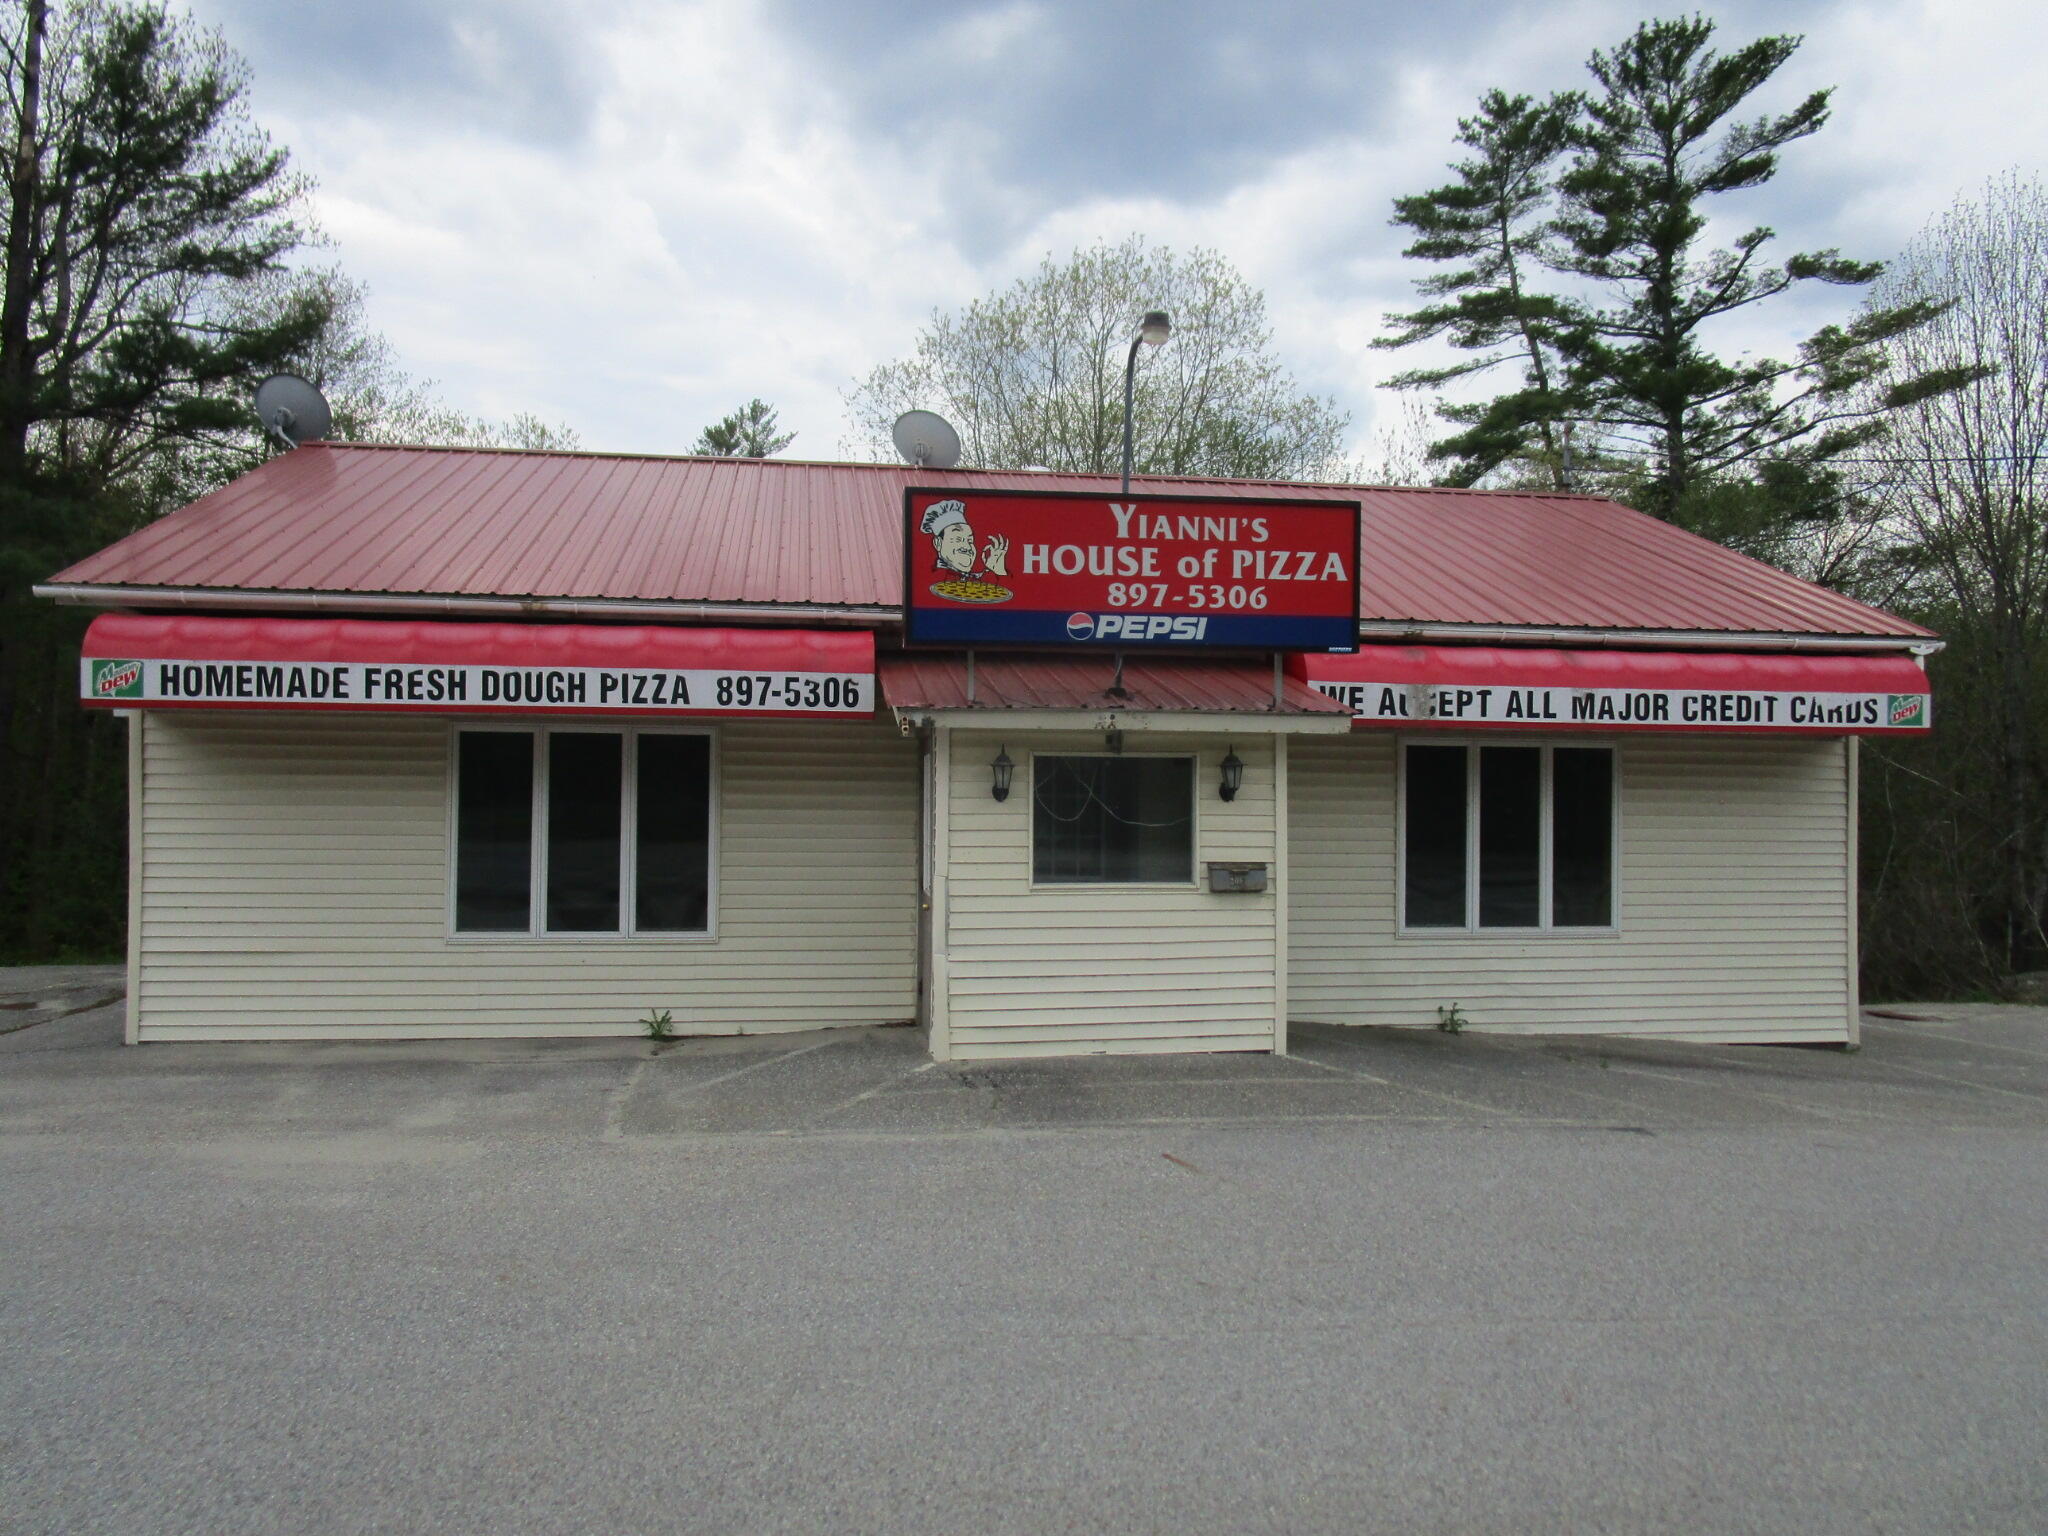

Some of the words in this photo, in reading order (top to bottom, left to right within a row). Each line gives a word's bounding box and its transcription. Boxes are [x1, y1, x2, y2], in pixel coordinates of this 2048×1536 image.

[1109, 503, 1269, 542] YIANNI'S
[1023, 543, 1161, 576] HOUSE
[1177, 549, 1219, 578] of
[1232, 550, 1348, 581] PIZZA
[1107, 582, 1268, 609] 897-5306
[1095, 615, 1208, 640] PEPSI
[160, 664, 350, 698] HOMEMADE
[364, 668, 467, 701] FRESH
[481, 670, 586, 703] DOUGH
[600, 673, 691, 705] PIZZA
[716, 676, 860, 708] 897-5306
[1378, 686, 1492, 718] AEPT
[1505, 690, 1557, 719] ALL
[1571, 693, 1669, 721] MAJOR
[1682, 694, 1779, 723] CREDIT
